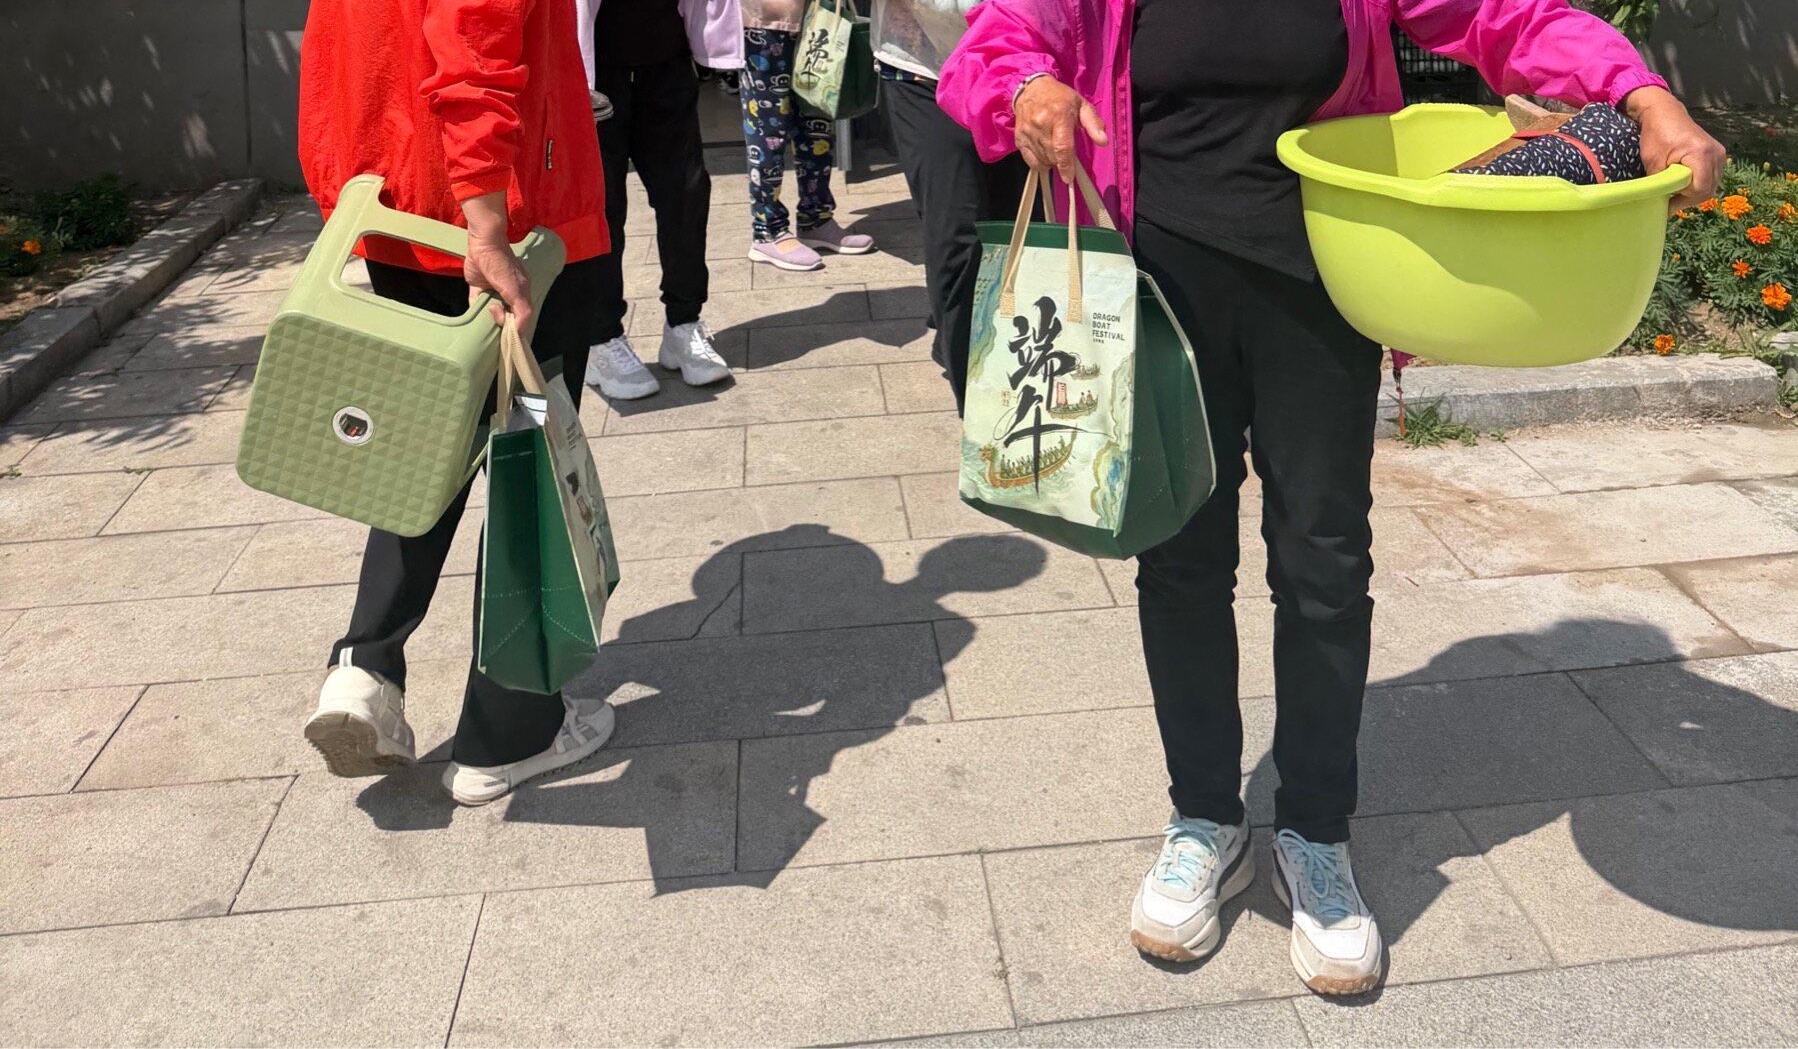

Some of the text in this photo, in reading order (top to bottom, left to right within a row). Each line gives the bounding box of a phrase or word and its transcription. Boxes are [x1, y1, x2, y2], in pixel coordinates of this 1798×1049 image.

[1092, 312, 1121, 323] DRAGON
[1092, 321, 1111, 330] BOAT
[1092, 329, 1125, 342] FESTIVAL
[997, 296, 1097, 497] 端午
